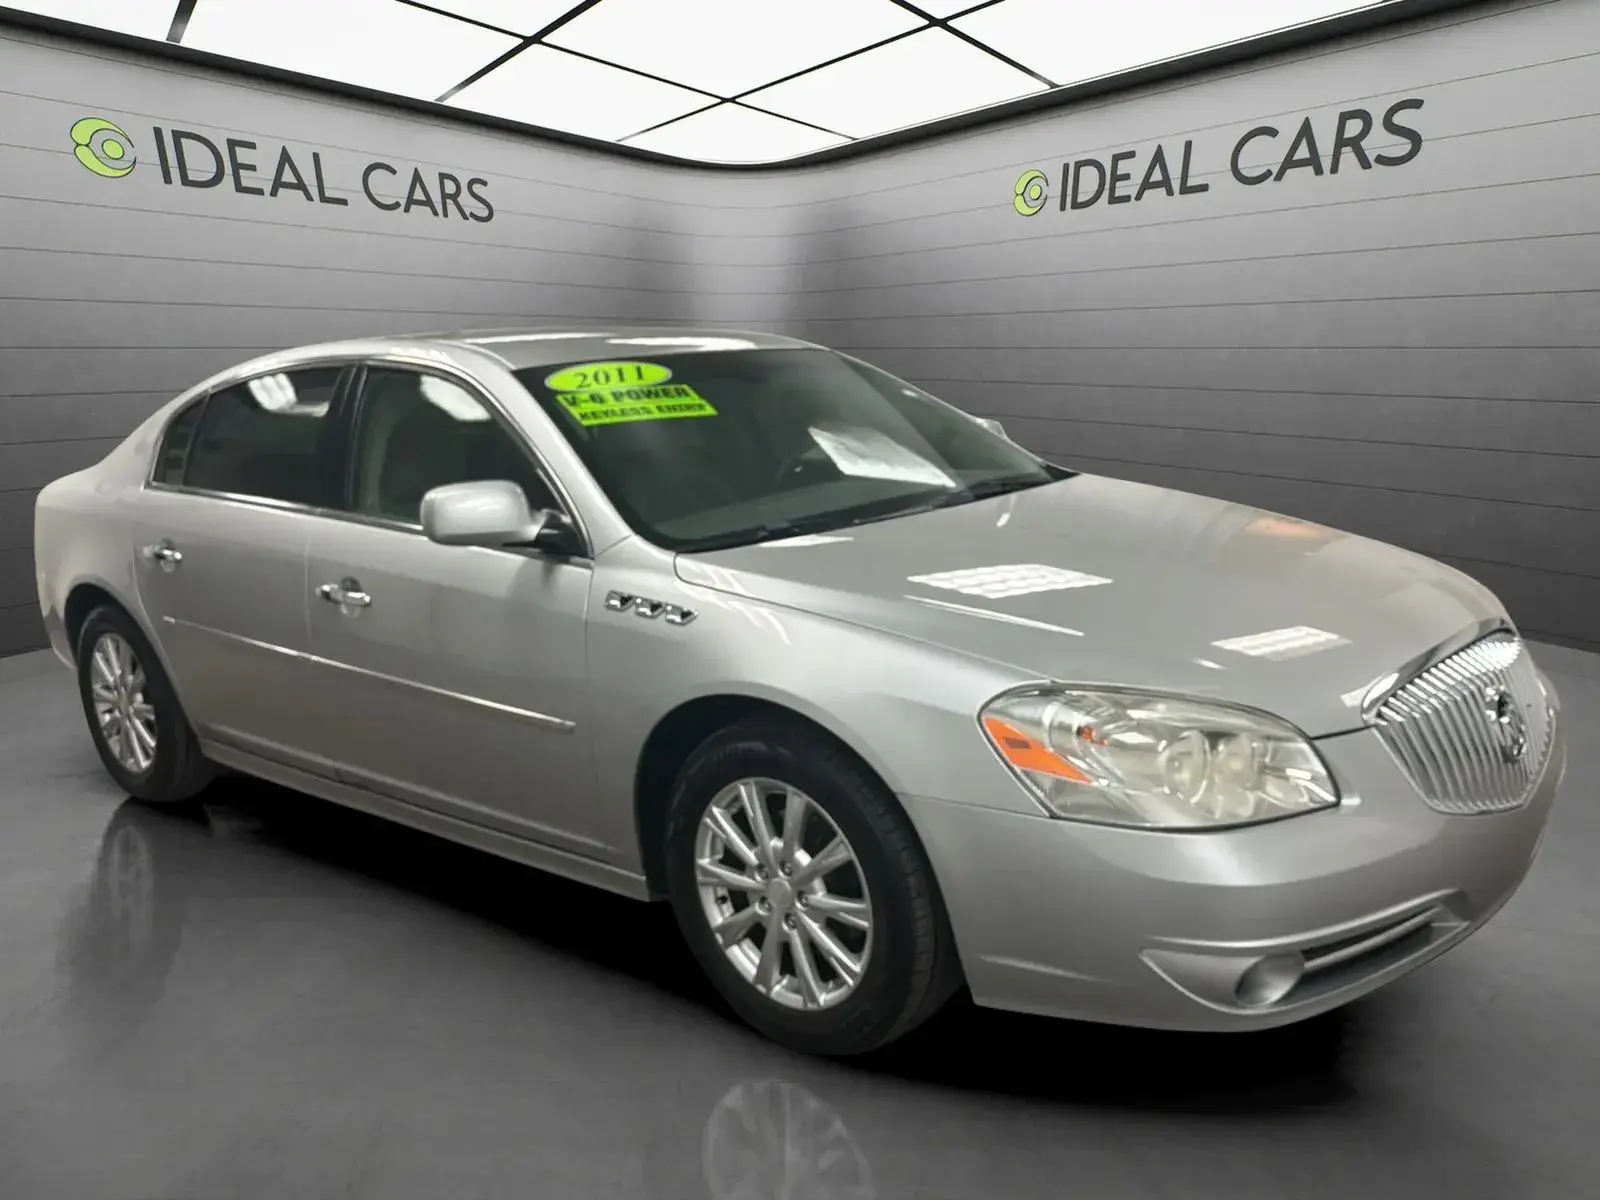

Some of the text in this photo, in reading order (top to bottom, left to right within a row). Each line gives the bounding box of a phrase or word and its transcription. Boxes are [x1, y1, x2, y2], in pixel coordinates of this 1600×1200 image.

[152, 126, 495, 223] IDEAL CARS
[1059, 98, 1425, 212] IDEAL CARS
[563, 387, 690, 407] V-6 POWER
[573, 365, 645, 389] 2011
